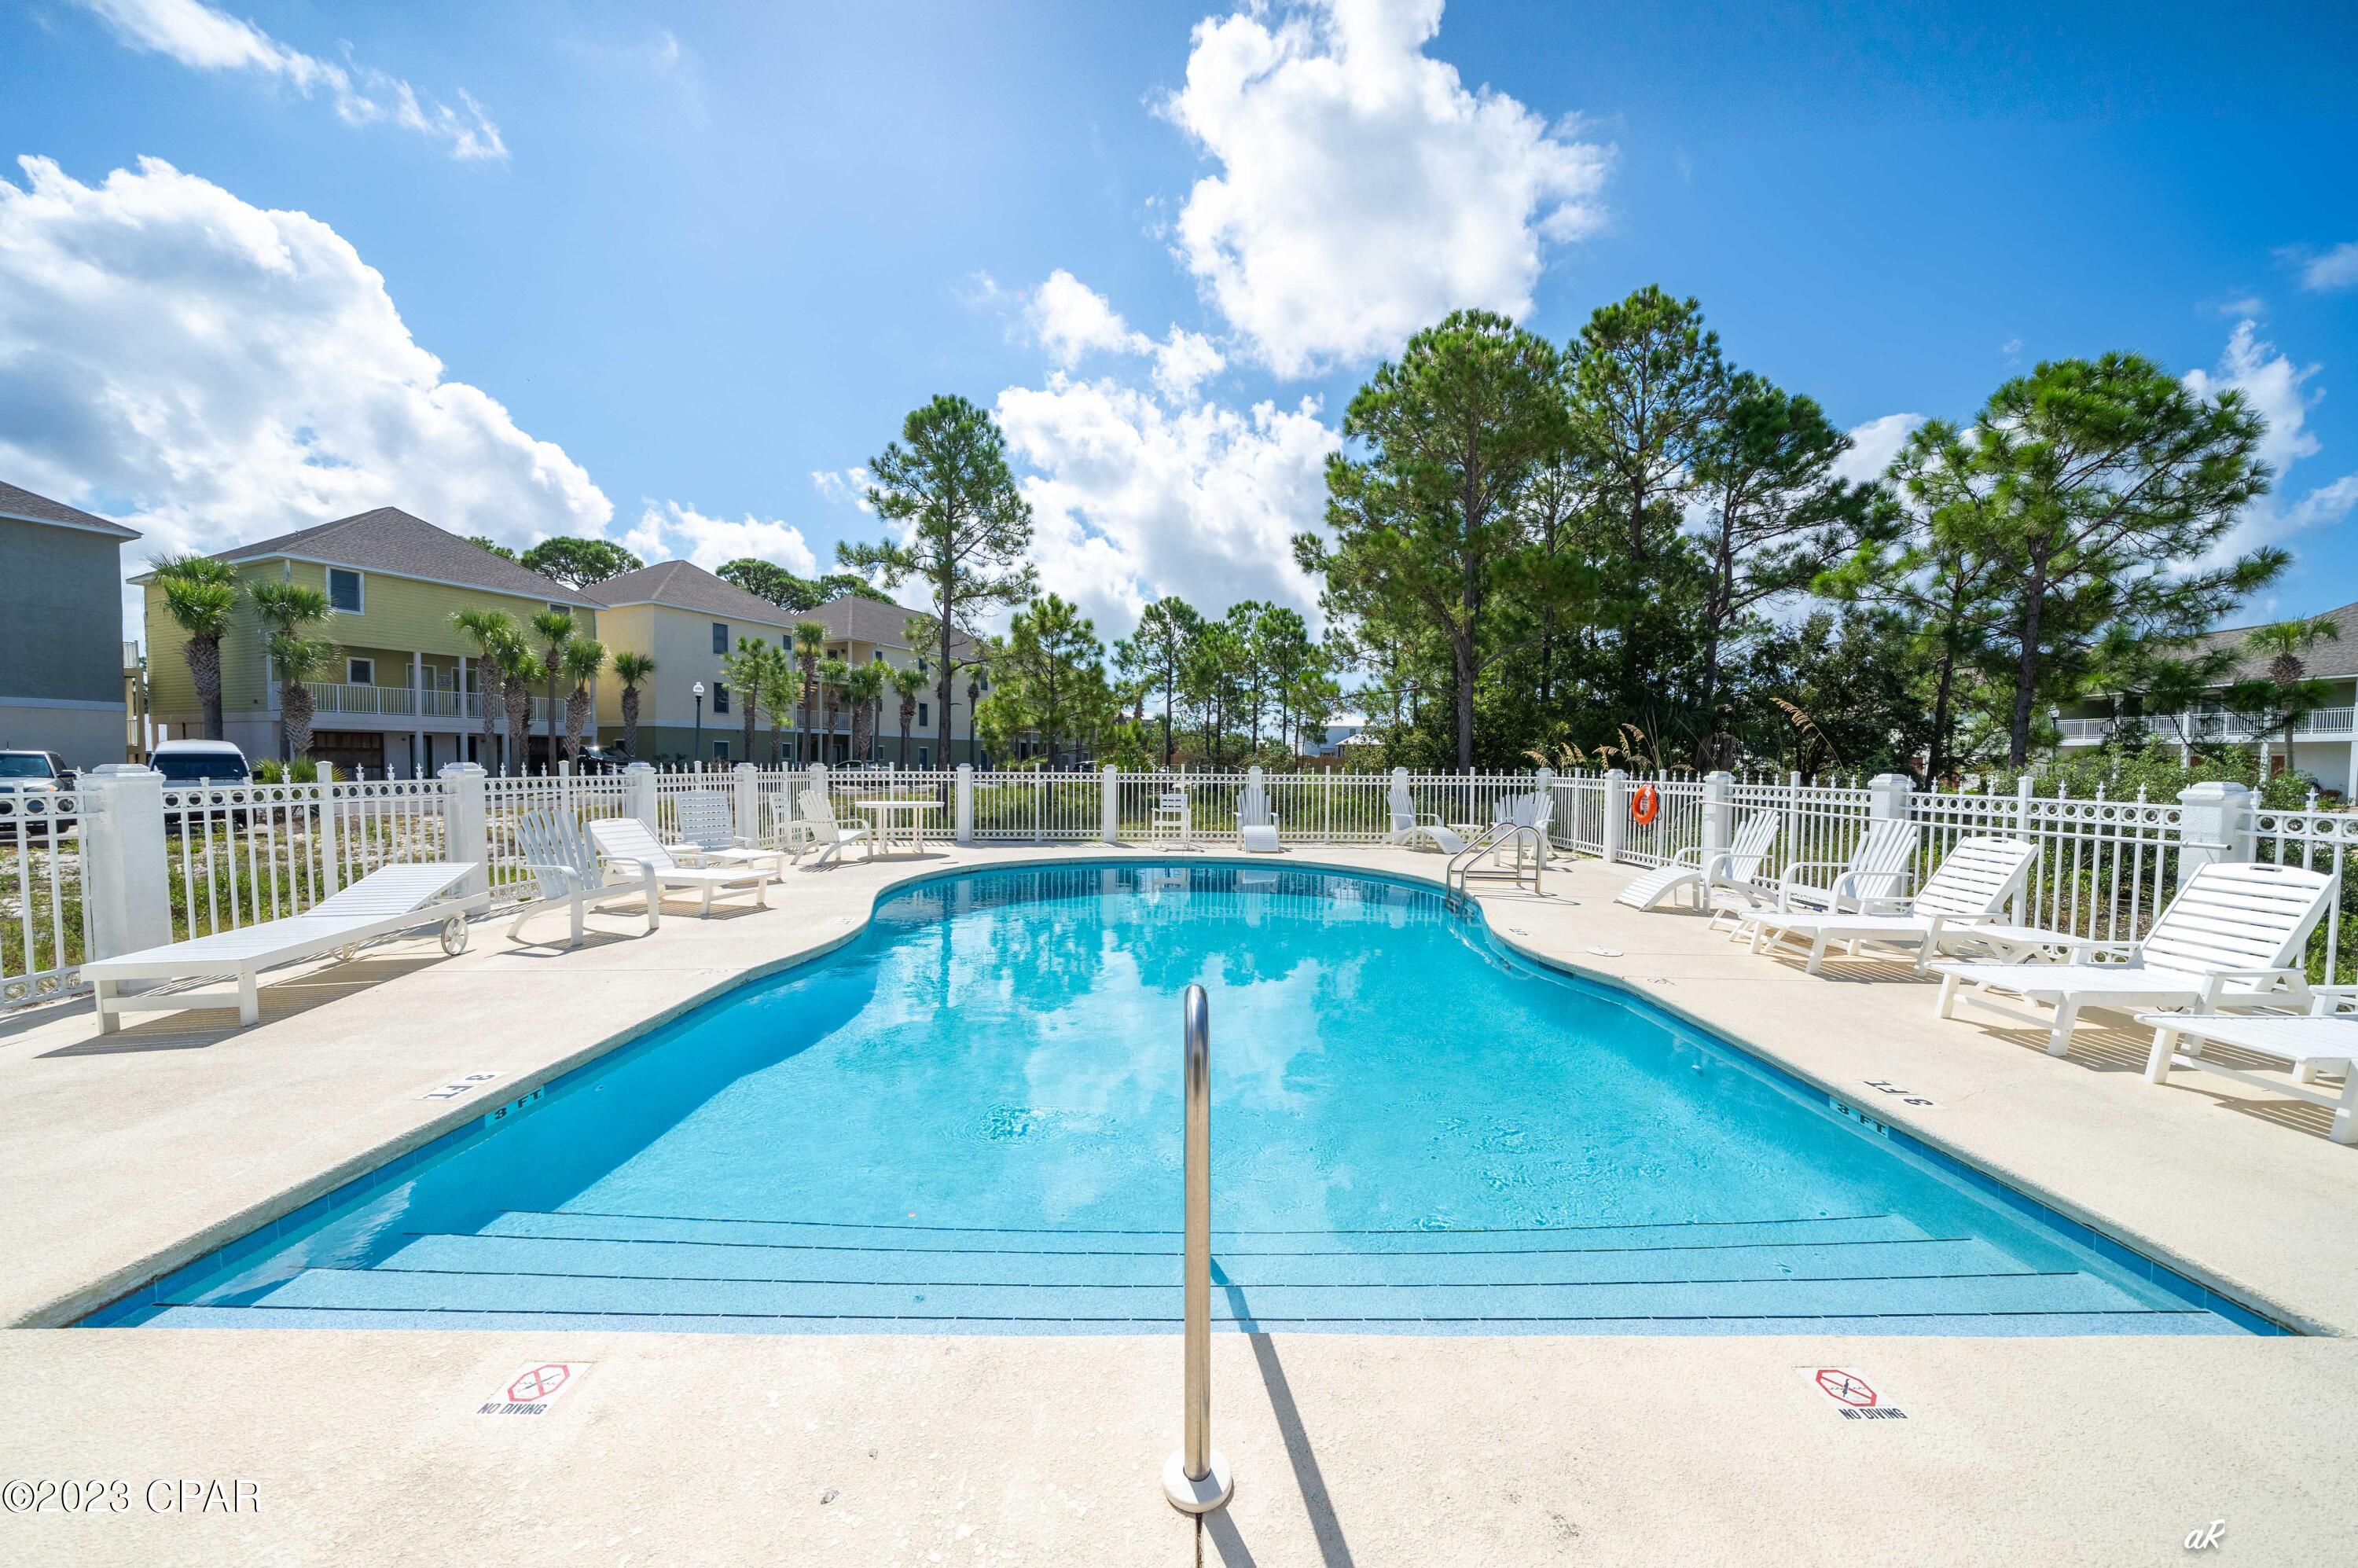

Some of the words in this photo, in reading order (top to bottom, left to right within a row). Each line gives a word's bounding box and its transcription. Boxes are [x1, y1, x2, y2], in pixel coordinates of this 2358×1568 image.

[494, 1107, 507, 1120] 3
[1837, 1103, 1849, 1115] 3
[476, 1403, 501, 1415] NO
[499, 1403, 548, 1416] DIVING
[1838, 1408, 1862, 1420] NO
[1859, 1408, 1908, 1420] DIVING
